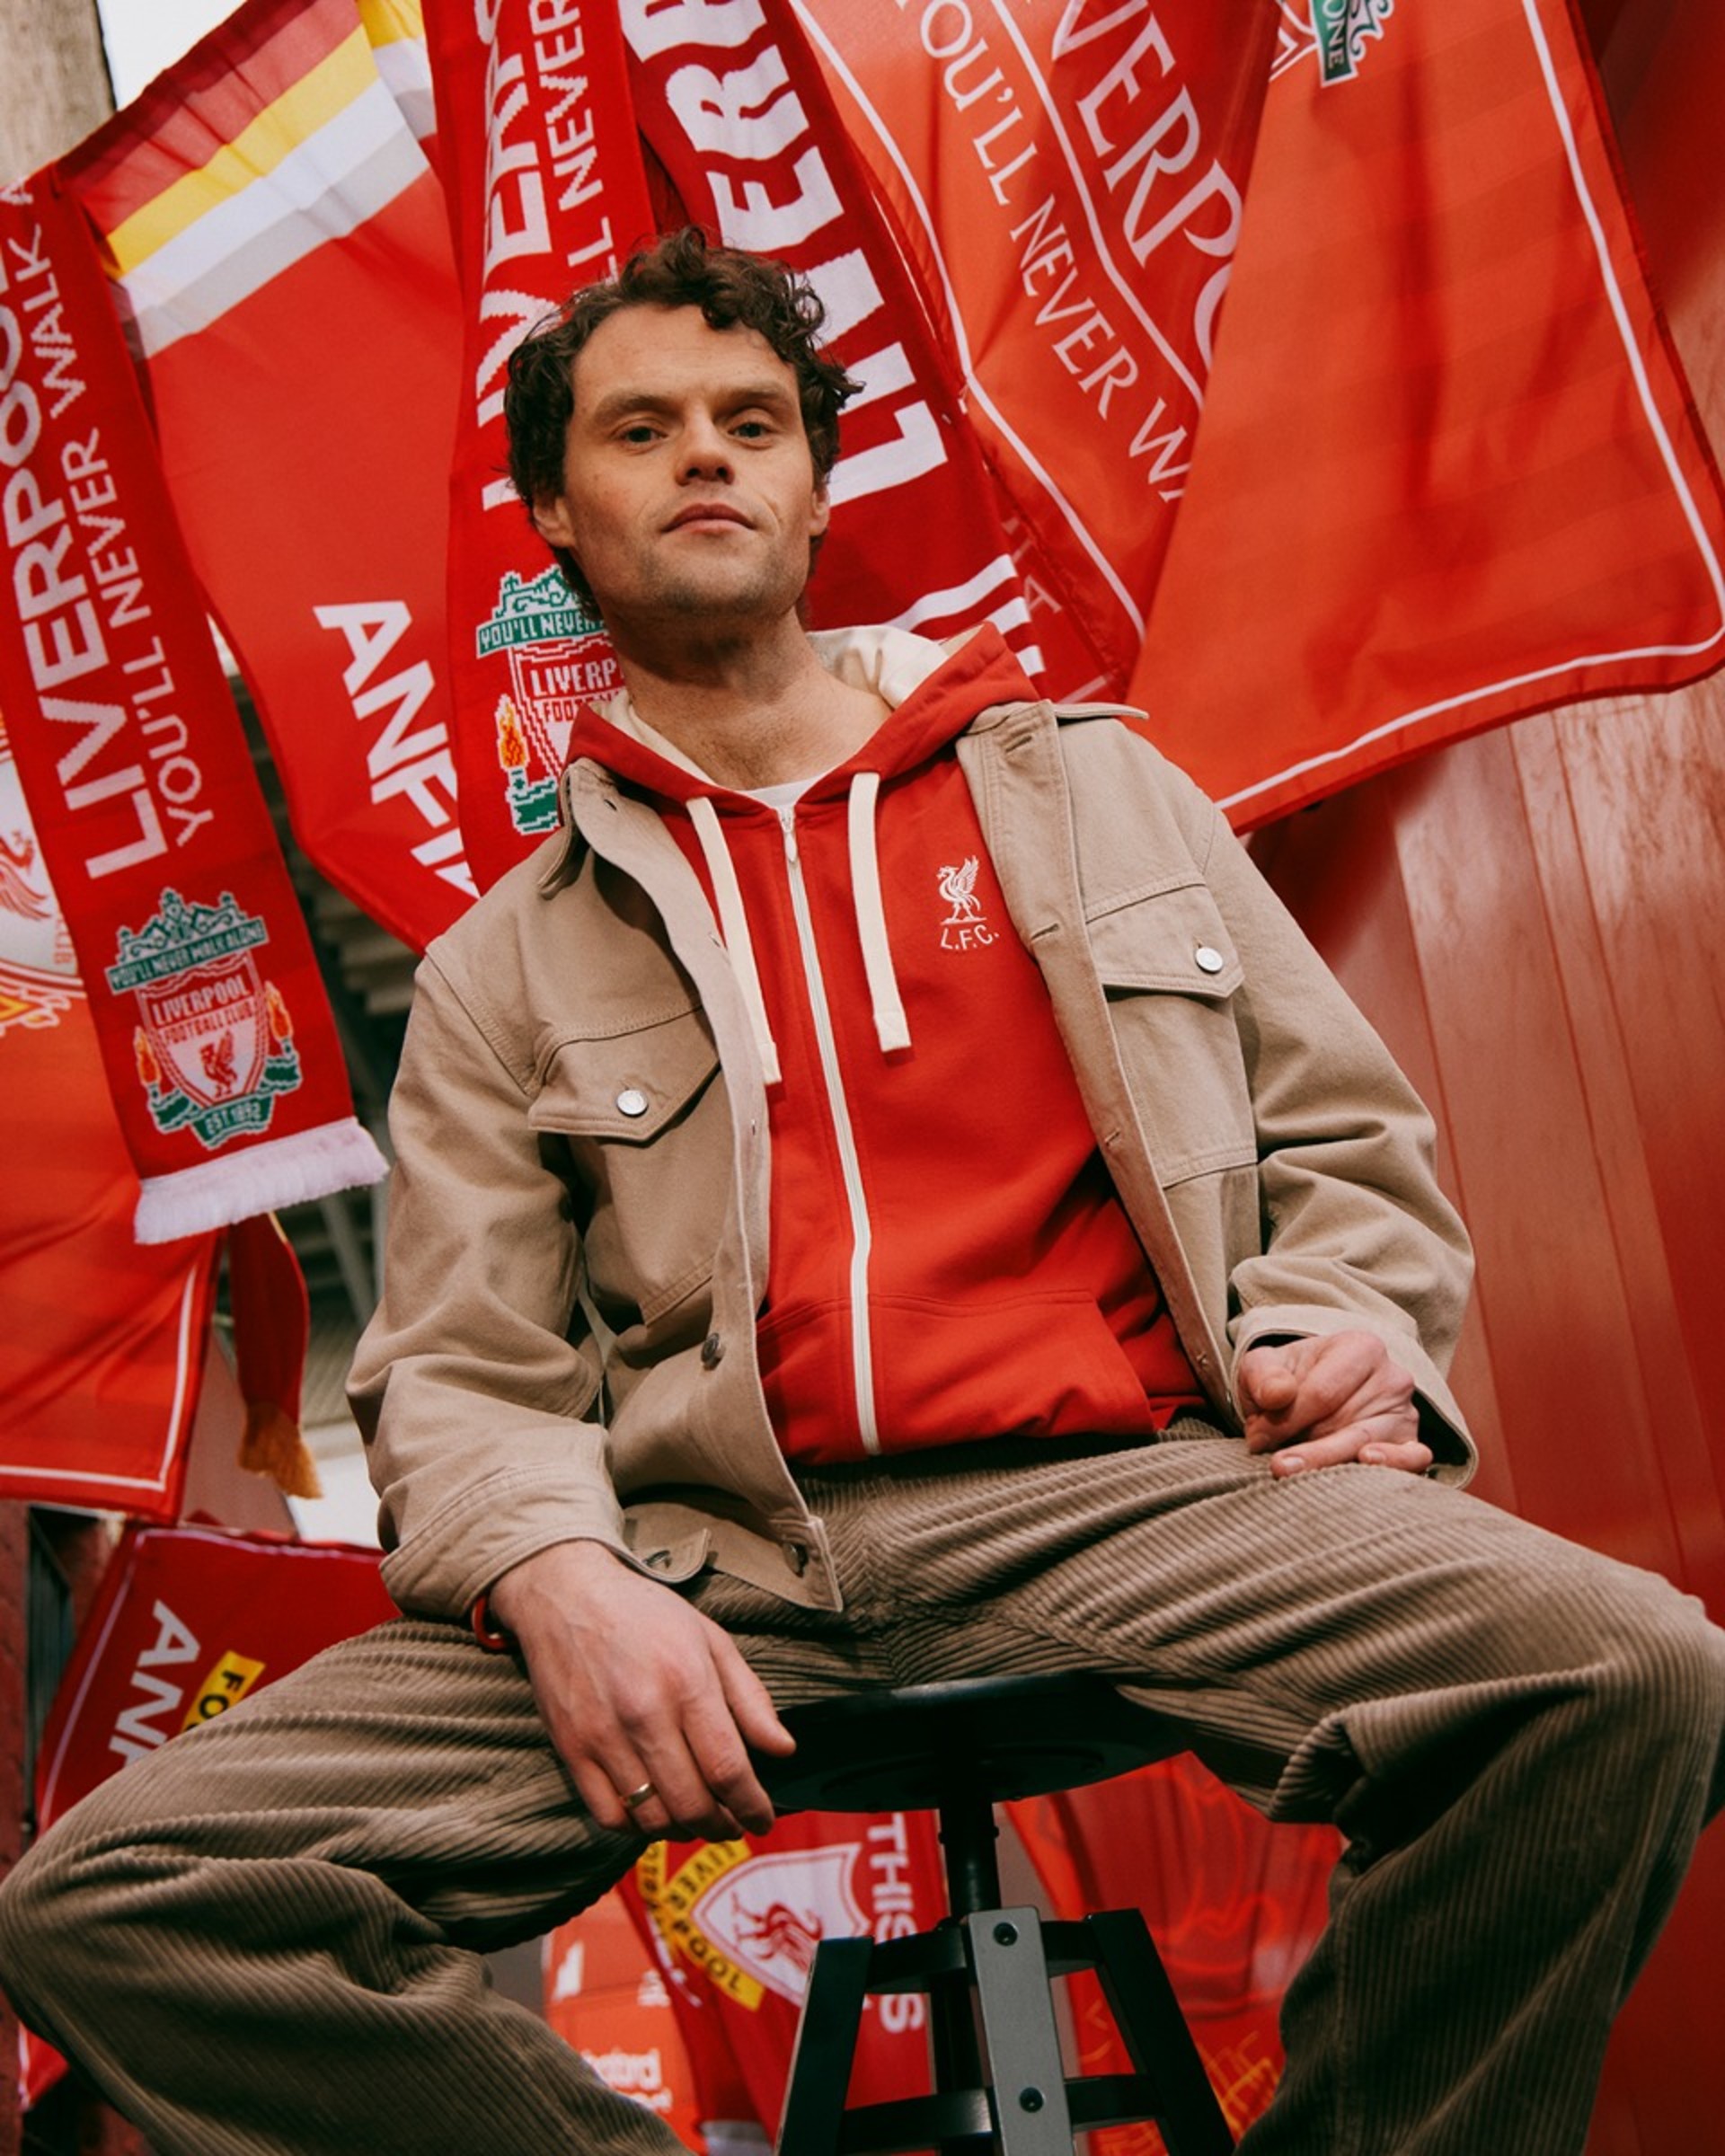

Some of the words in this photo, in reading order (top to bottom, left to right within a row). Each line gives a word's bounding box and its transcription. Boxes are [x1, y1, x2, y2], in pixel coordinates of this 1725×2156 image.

[898, 0, 1039, 206] OU'LL
[1010, 194, 1139, 420] NEVER
[7, 223, 86, 420] WALK
[60, 427, 153, 629] NEVER
[479, 617, 537, 649] YOU'LL
[530, 657, 618, 698] LIVERP
[122, 636, 215, 847] YOU'LL
[940, 923, 1000, 950] L.F.C.
[151, 973, 251, 1026] LIVERPOOL
[204, 1108, 230, 1135] EST
